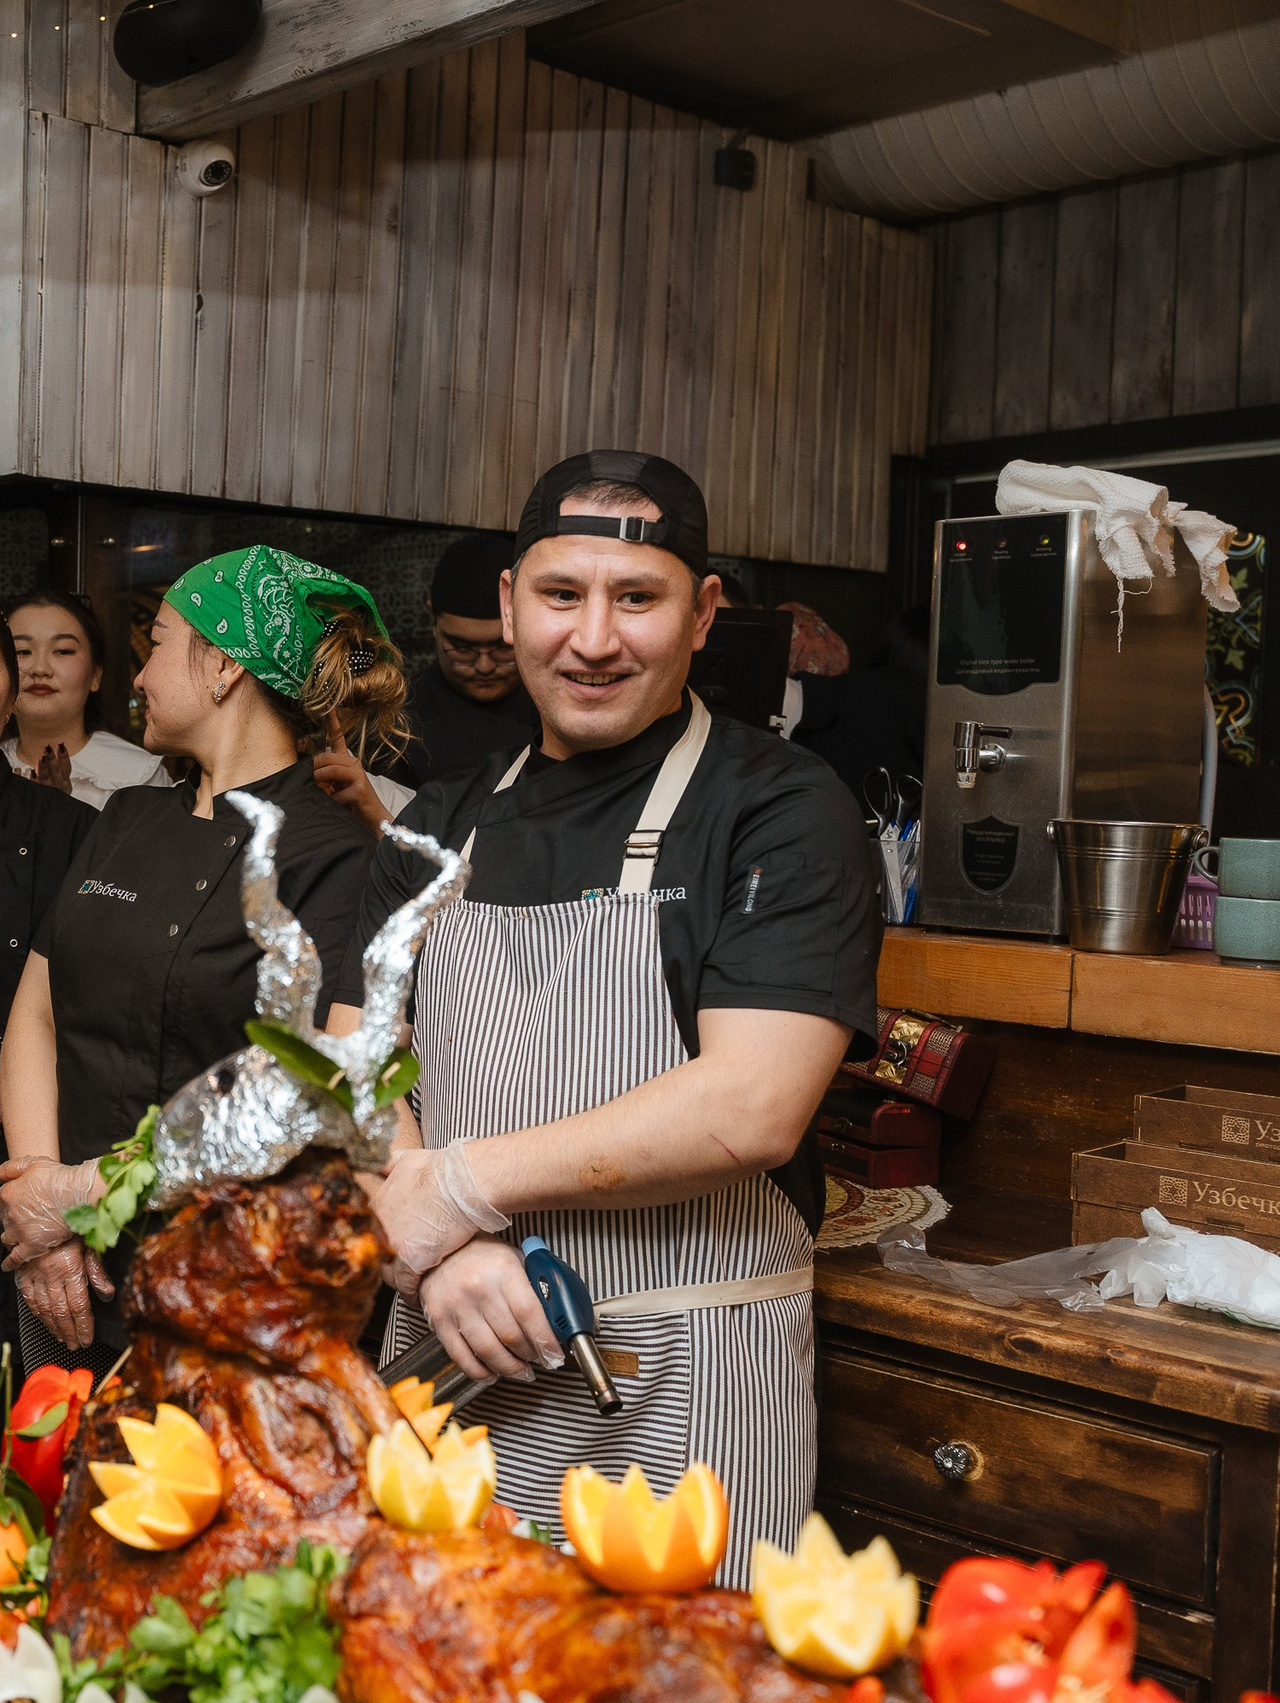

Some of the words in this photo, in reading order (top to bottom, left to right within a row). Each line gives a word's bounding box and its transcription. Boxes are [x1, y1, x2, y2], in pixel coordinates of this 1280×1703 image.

[976, 836, 1006, 844] WARNING
[90, 880, 138, 902] Узбечка
[606, 886, 687, 902] Учка
[1192, 1181, 1280, 1215] Узбечк
